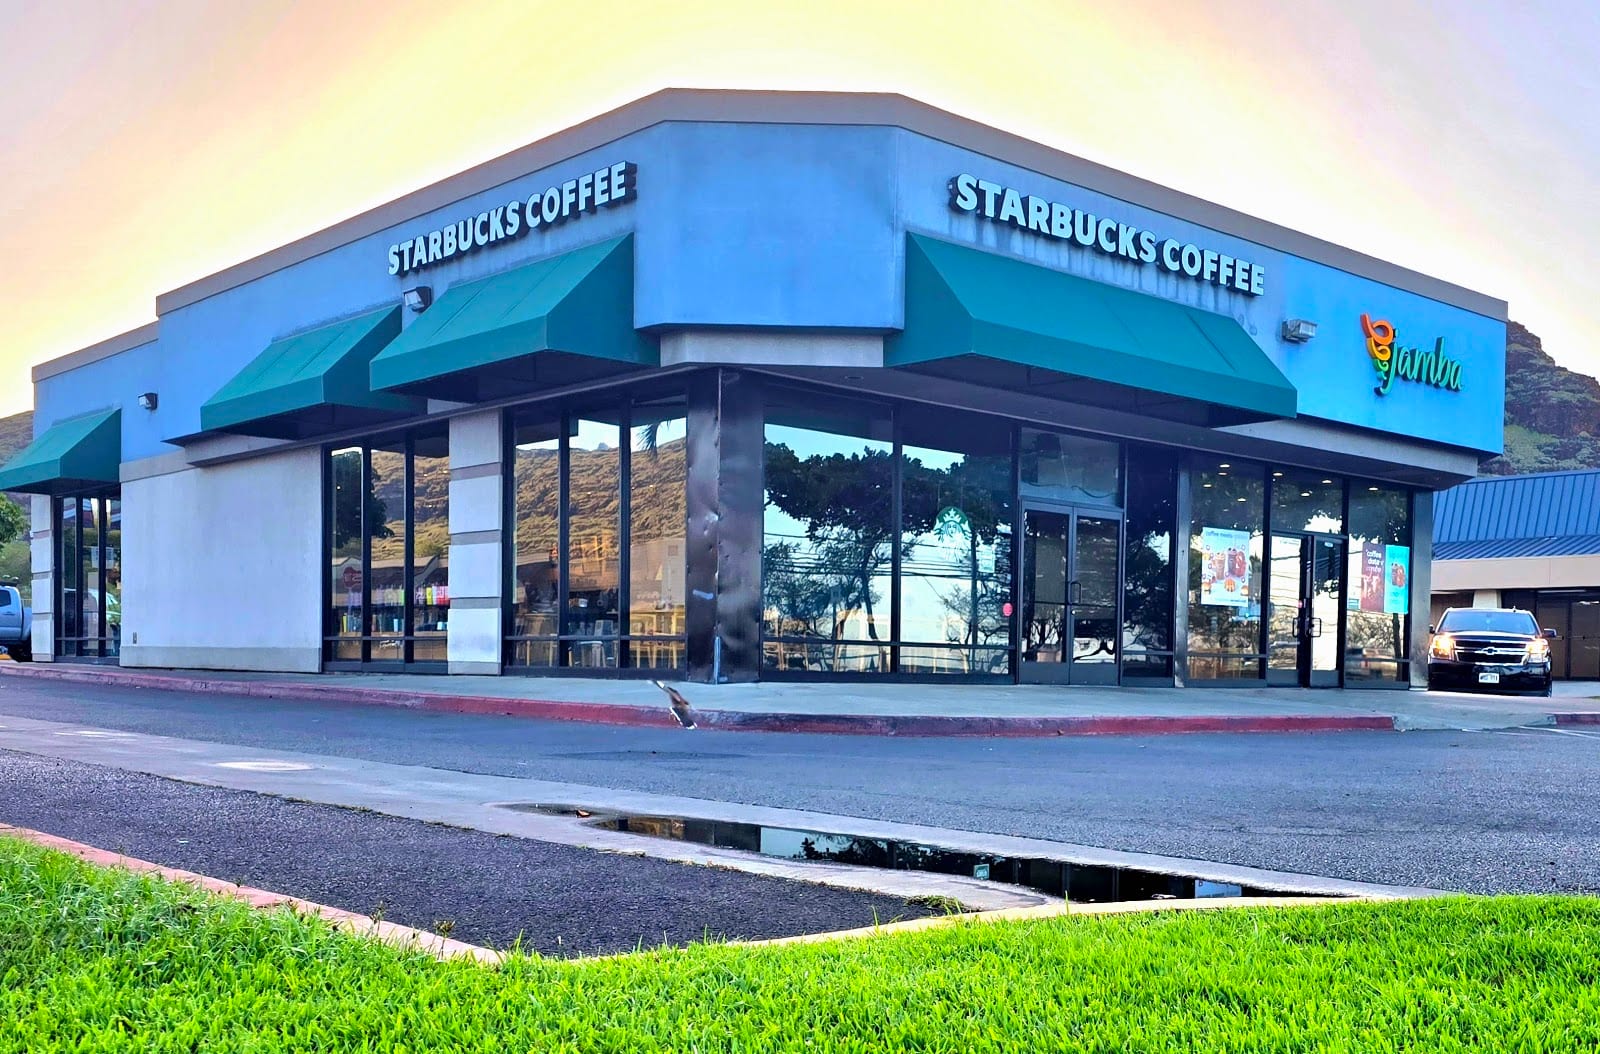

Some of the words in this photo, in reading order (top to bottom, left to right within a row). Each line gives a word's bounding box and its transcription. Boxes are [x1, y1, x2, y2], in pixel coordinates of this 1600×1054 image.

[388, 201, 521, 276] STARBUCKS
[525, 160, 628, 228] COFFEE
[954, 173, 1157, 263] STARBUCKS
[1162, 238, 1265, 296] COFFEE
[1379, 327, 1464, 395] jamba
